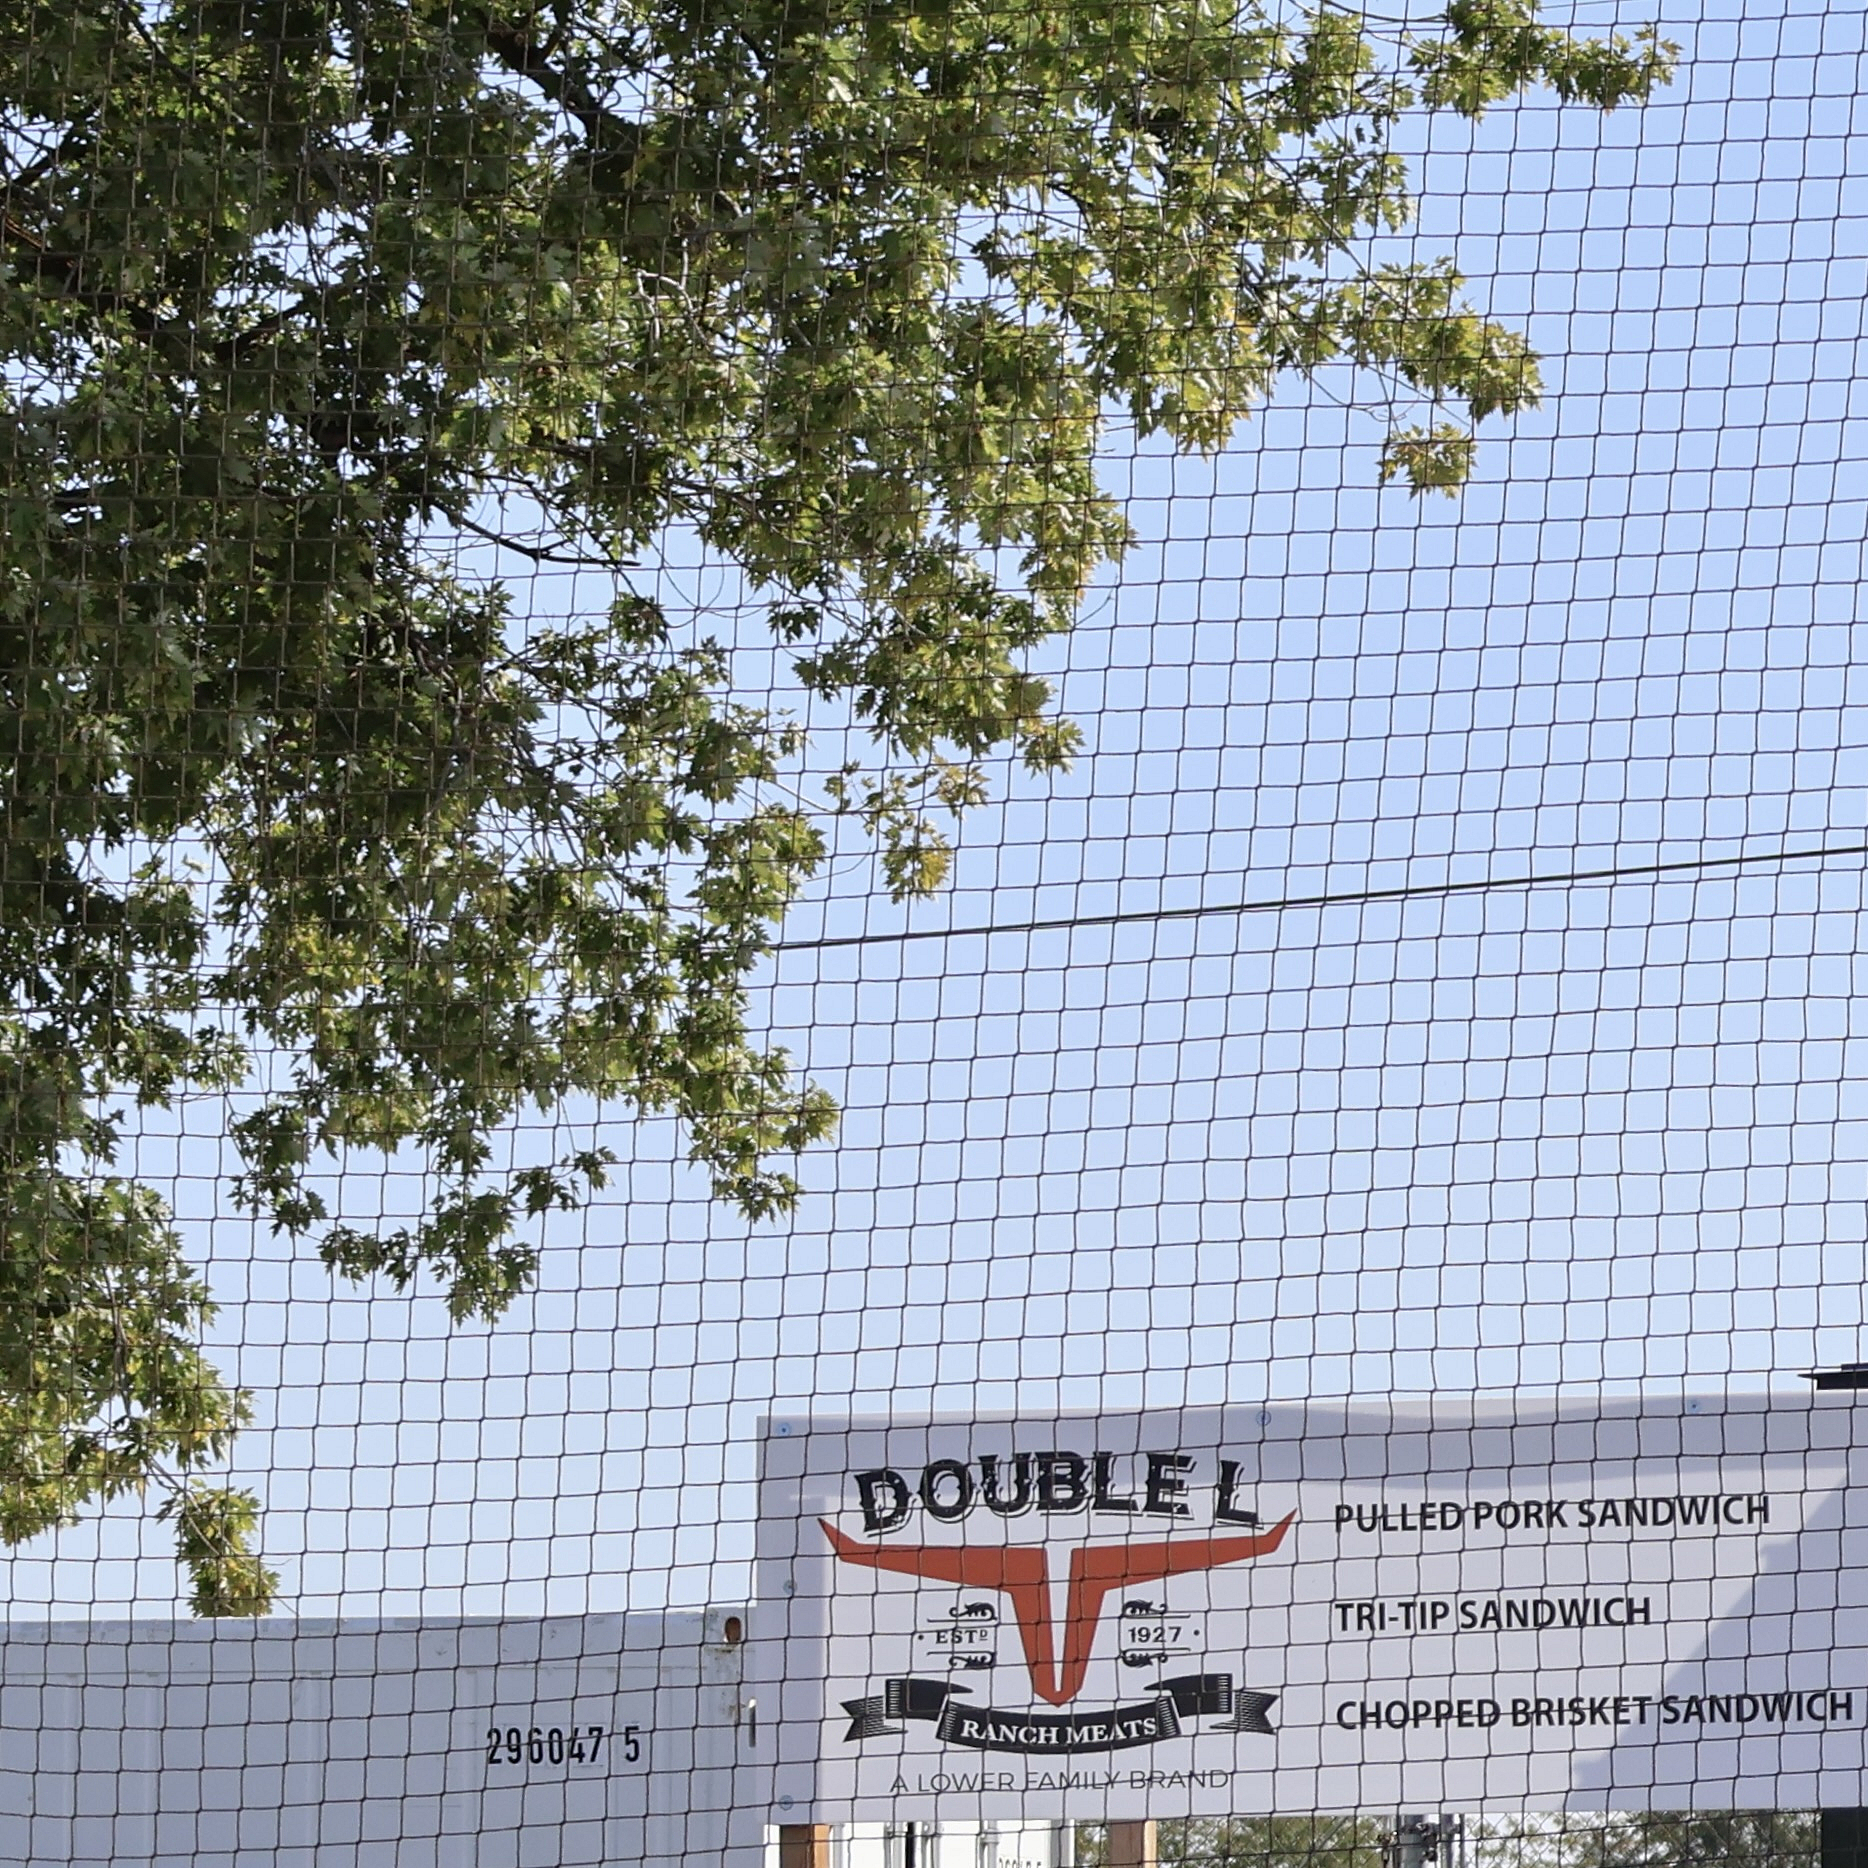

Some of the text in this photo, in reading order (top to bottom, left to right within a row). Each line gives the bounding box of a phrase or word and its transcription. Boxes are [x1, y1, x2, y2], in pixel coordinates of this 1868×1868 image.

[854, 1450, 1264, 1537] DOUBLE L
[1335, 1501, 1462, 1534] PULLED
[1473, 1499, 1568, 1531] PORK
[1577, 1494, 1770, 1528] SANDWICH
[1335, 1600, 1451, 1632] TRI-TIP
[1460, 1595, 1652, 1630] SANDWICH
[1127, 1626, 1183, 1643] 1927
[1337, 1698, 1501, 1732] CHOPPED
[1510, 1694, 1653, 1728] BRISKET
[1662, 1690, 1854, 1726] SANDWICH
[487, 1725, 640, 1765] 296047 5
[960, 1716, 1158, 1745] RANCH MEATS
[889, 1768, 1229, 1793] A LOWER FAMILY BRAND
